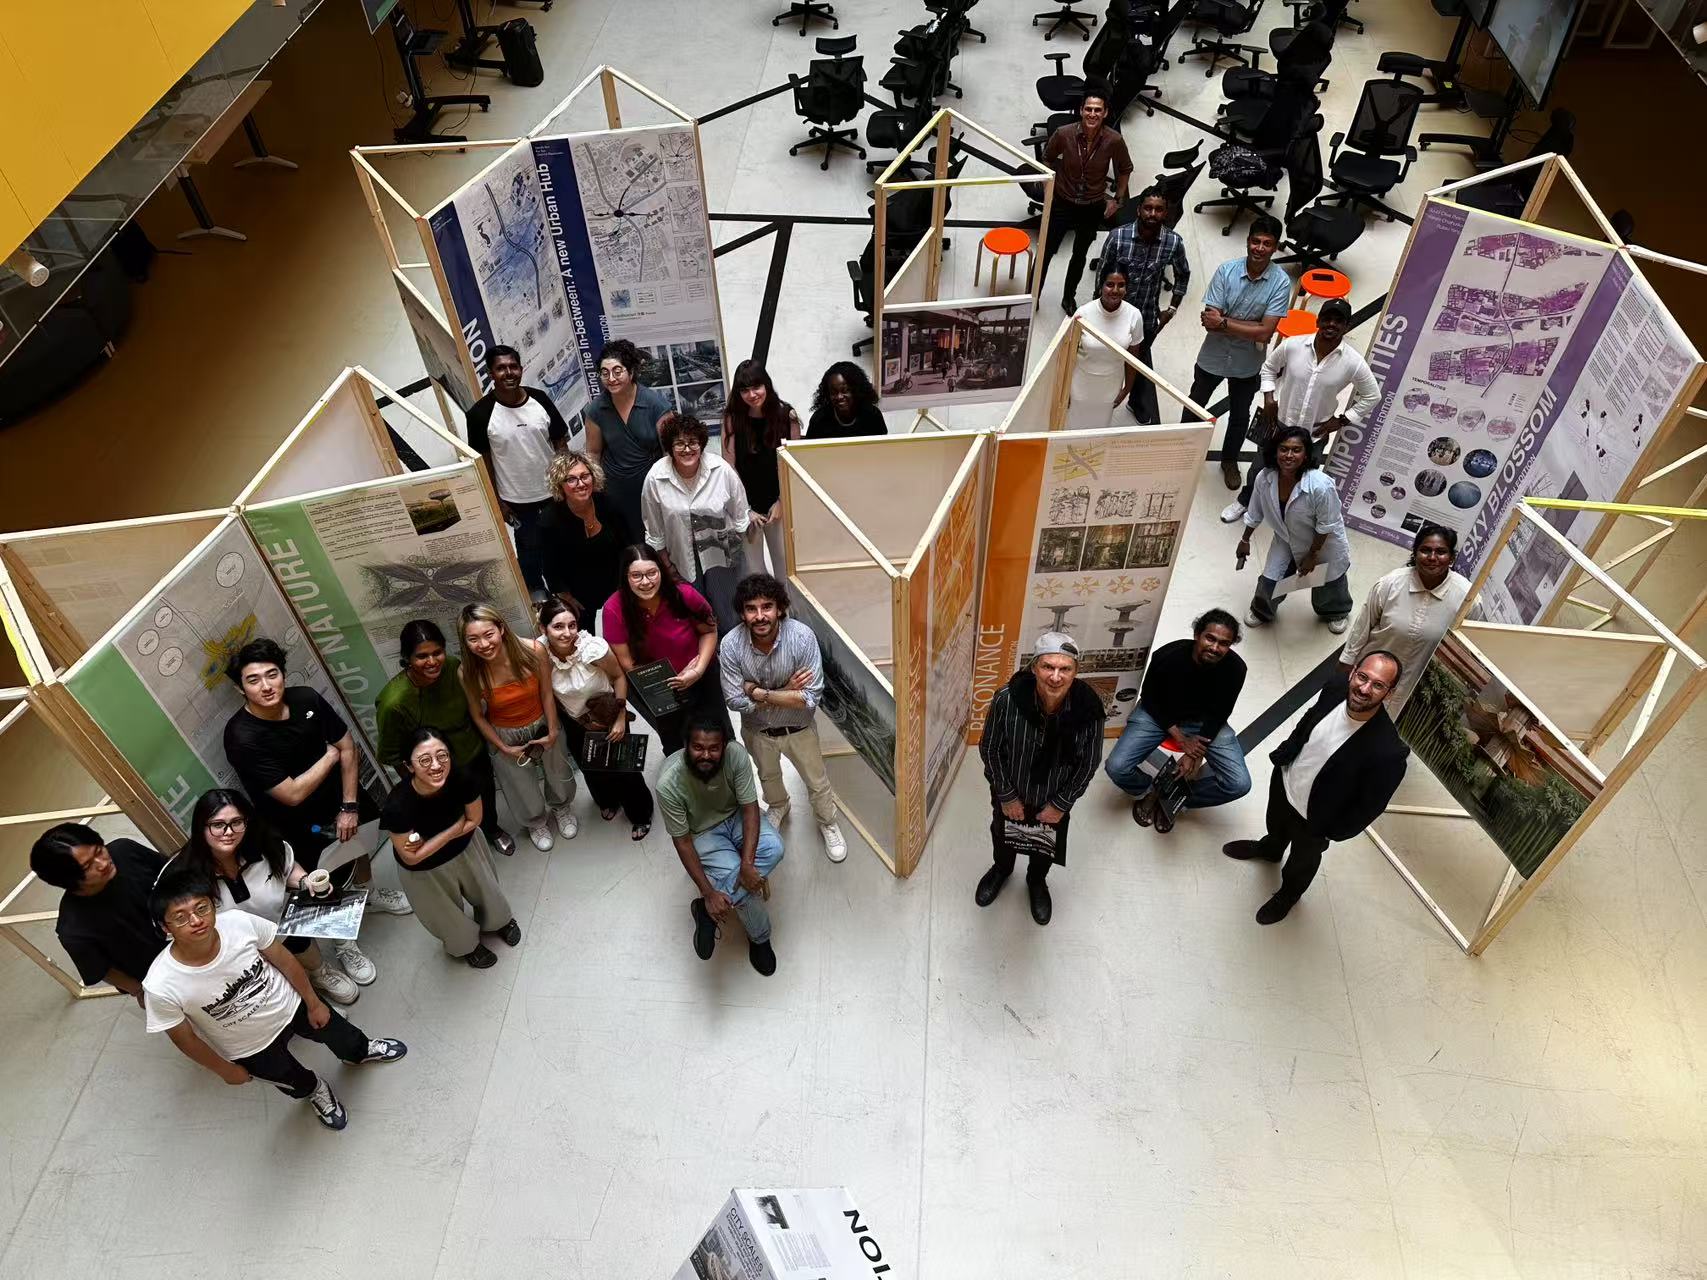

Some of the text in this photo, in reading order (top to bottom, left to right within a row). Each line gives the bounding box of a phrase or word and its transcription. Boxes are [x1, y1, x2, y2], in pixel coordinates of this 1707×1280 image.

[536, 163, 553, 192] Hub
[545, 195, 564, 237] Urban
[556, 240, 571, 266] new
[561, 268, 573, 278] A
[565, 281, 590, 349] In-between:
[583, 352, 595, 370] the
[1342, 390, 1396, 509] CITY SCALES SHANGHAI EDITION
[1463, 510, 1488, 563] SKY
[1487, 384, 1557, 516] BLOSSOM
[1514, 454, 1536, 486] EDITION
[267, 537, 350, 658] NATURE
[329, 663, 370, 696] OF
[970, 624, 1005, 731] RESONANCE
[238, 1005, 260, 1022] SCALES
[730, 1207, 744, 1230] CITY
[742, 1231, 764, 1272] SCALES
